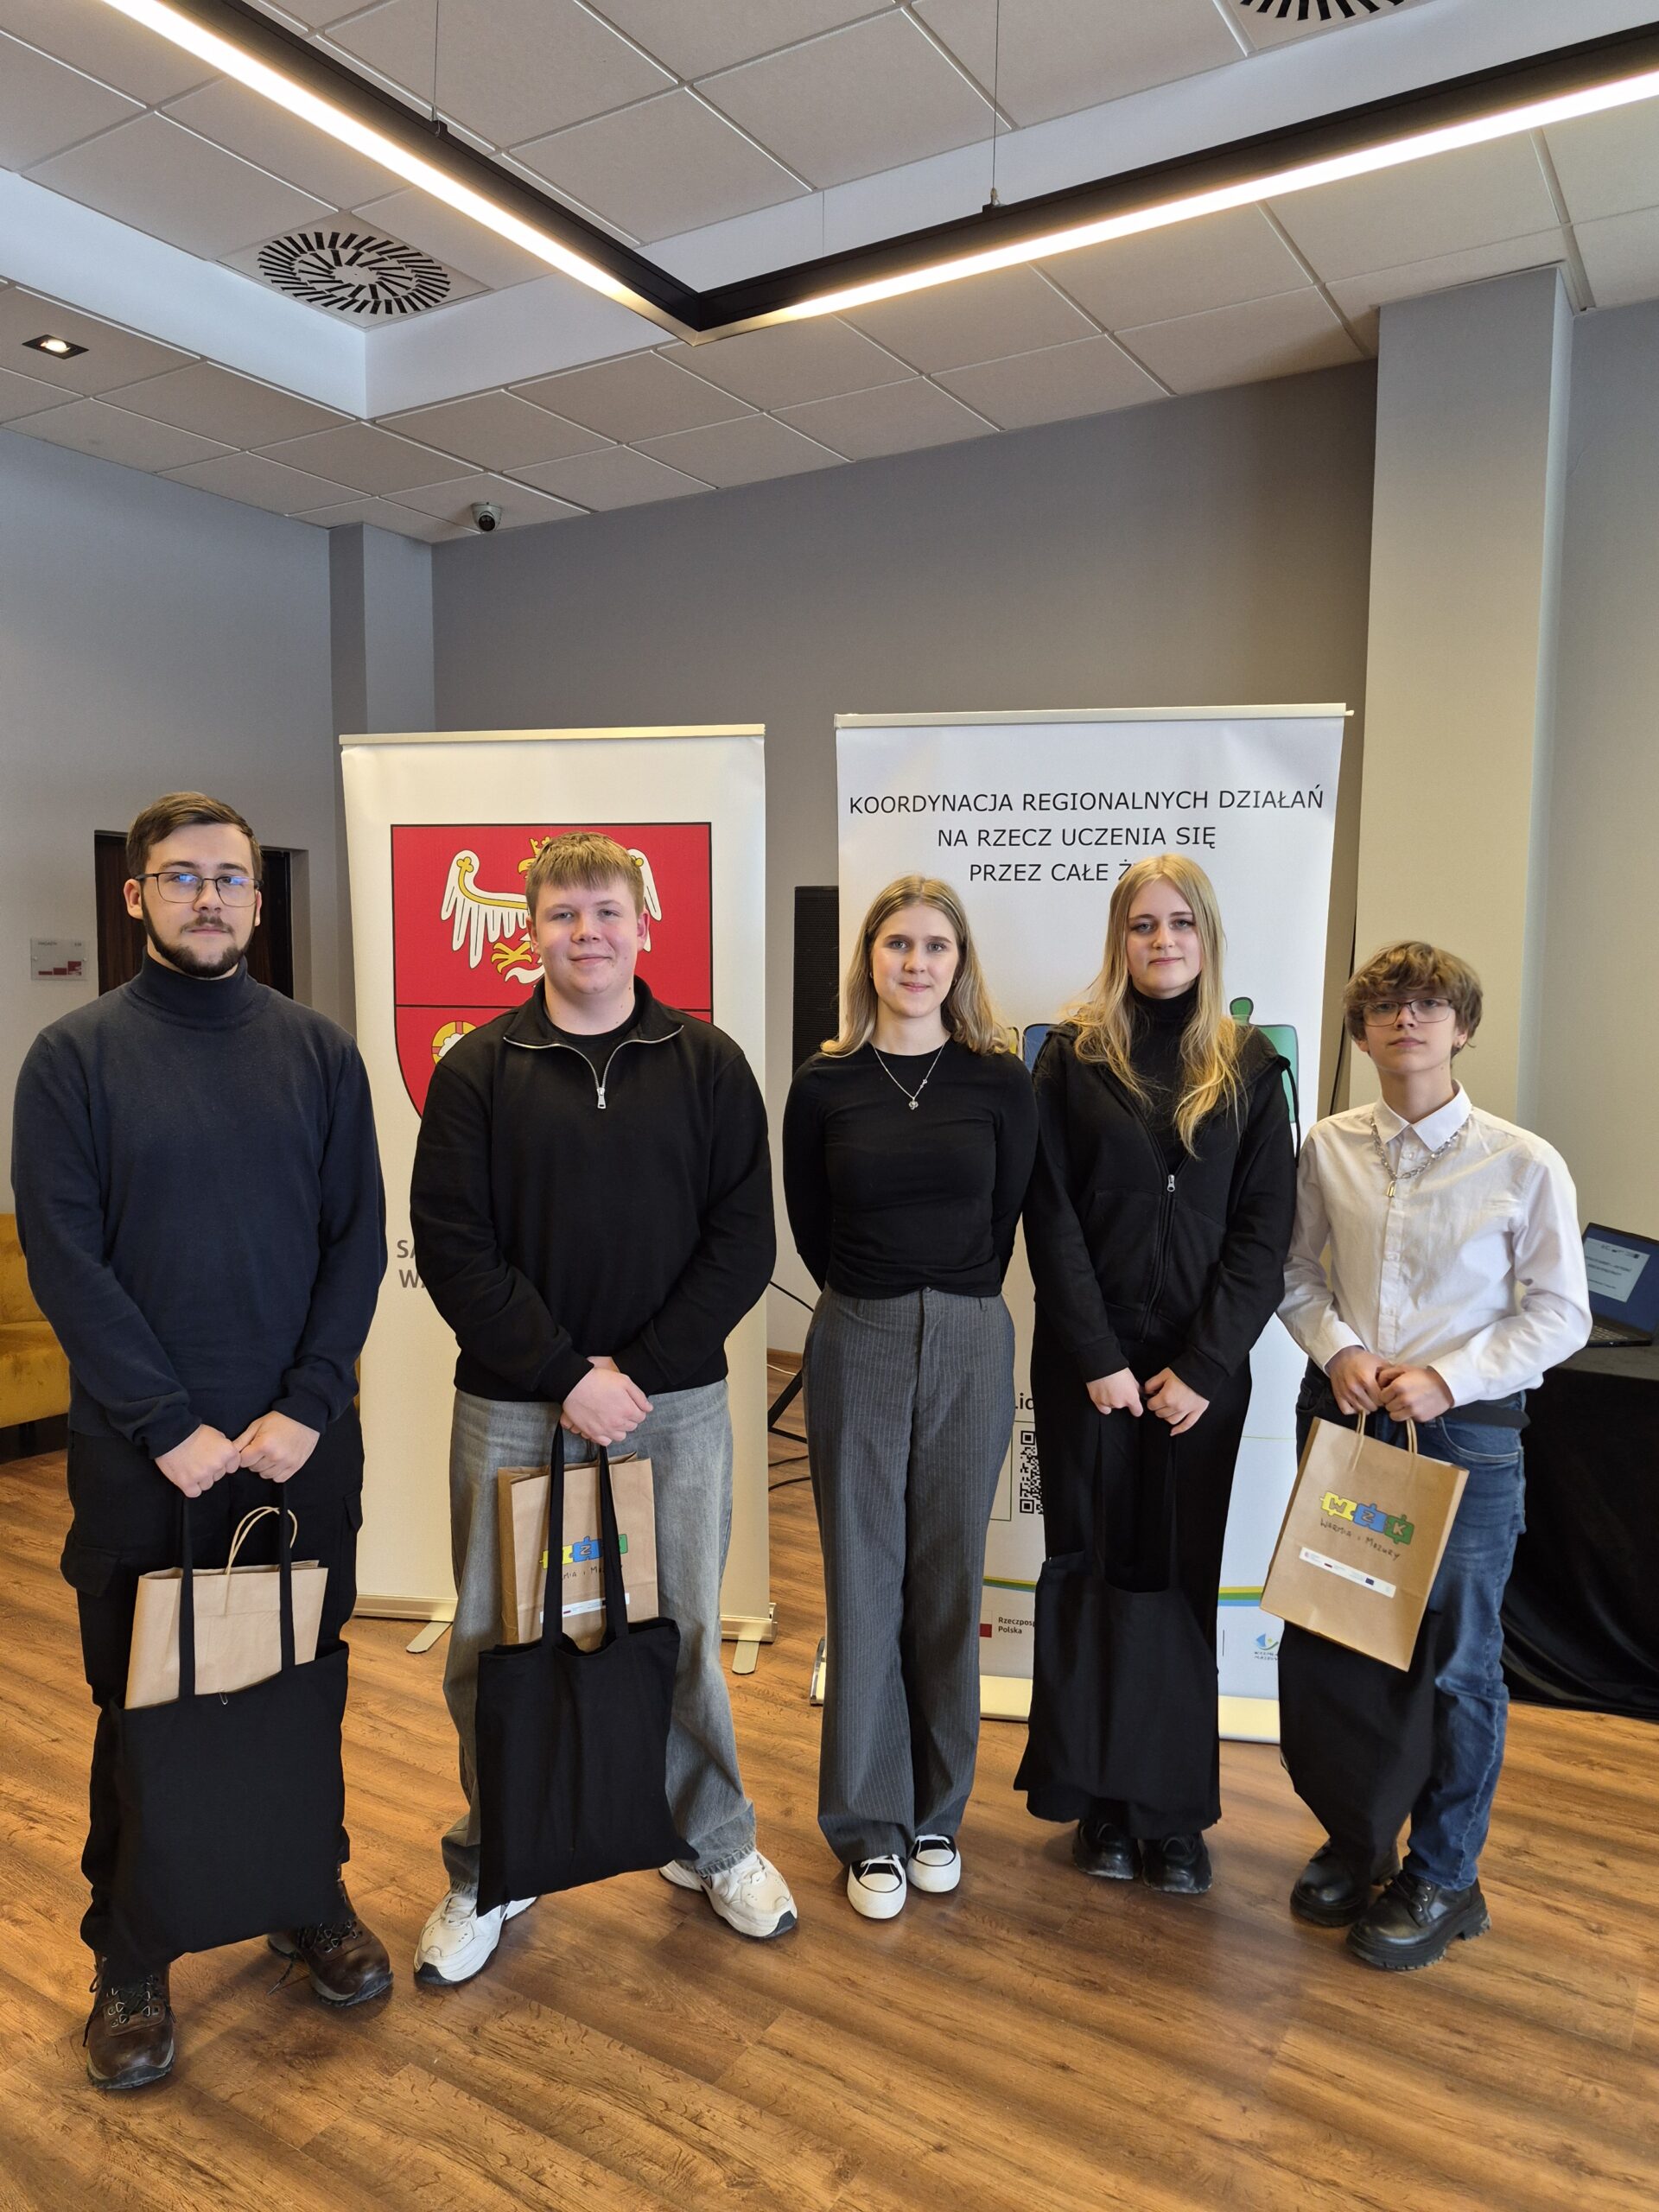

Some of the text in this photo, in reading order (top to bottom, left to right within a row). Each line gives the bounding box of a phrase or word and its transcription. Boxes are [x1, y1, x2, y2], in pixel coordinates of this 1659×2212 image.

[850, 784, 1324, 814] KOORDYNACJA REGIONALNYCH DZIAŁAŃ
[938, 826, 1216, 849] NA RZECZ UCZENIA SIĘ
[969, 863, 1042, 881] PRZEZ
[1051, 862, 1109, 881] CAŁE
[398, 1269, 427, 1288] W
[998, 1625, 1023, 1634] Polska
